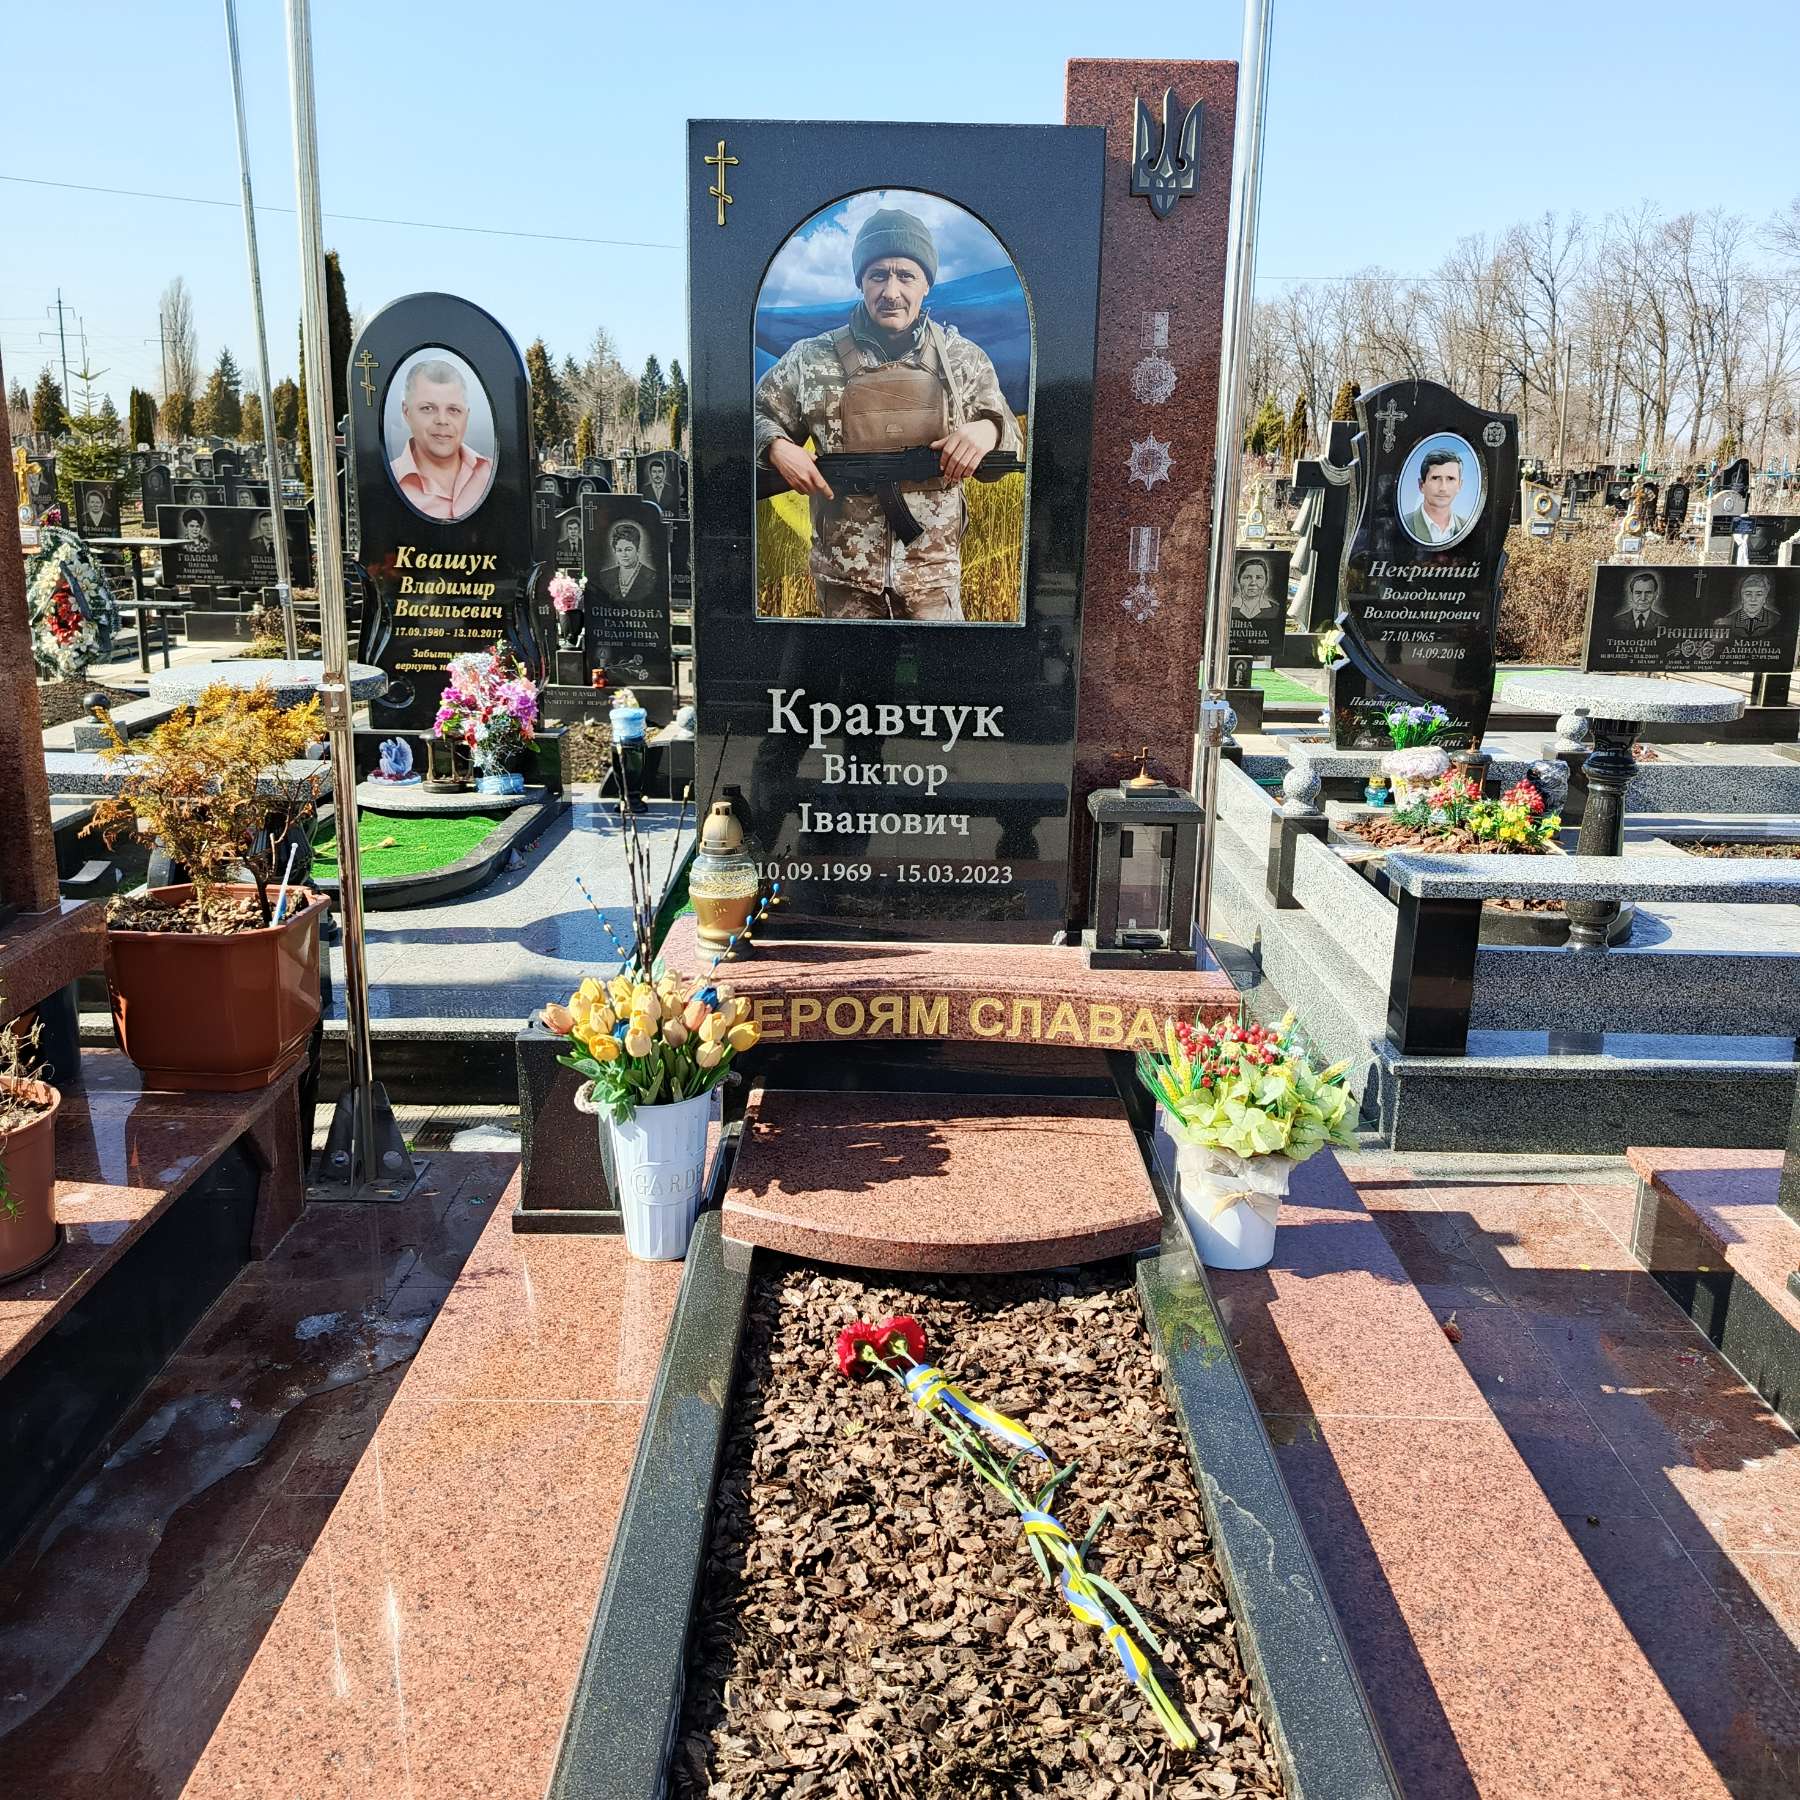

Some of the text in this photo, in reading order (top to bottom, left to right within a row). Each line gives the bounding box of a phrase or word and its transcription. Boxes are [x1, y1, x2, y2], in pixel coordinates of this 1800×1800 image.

[394, 546, 498, 576] Квашук
[1368, 560, 1481, 582] Некритий
[399, 576, 496, 600] Владимир
[1381, 587, 1466, 604] Володимир
[393, 599, 503, 618] Васильевич
[1363, 606, 1481, 622] Володимирович
[395, 627, 445, 637] 17.09.1980
[453, 628, 503, 638] 13.10.2017
[1380, 630, 1436, 642] 27.10.1965
[1411, 647, 1466, 660] 14.09.2018
[767, 688, 1005, 753] Кравчук
[822, 753, 948, 796] Віктор
[798, 802, 970, 836] Іванович
[756, 861, 873, 881] 10.09.1969
[897, 864, 1013, 884] 15.03.2023
[753, 996, 1165, 1050] ЕРОЯМ СЛАВА
